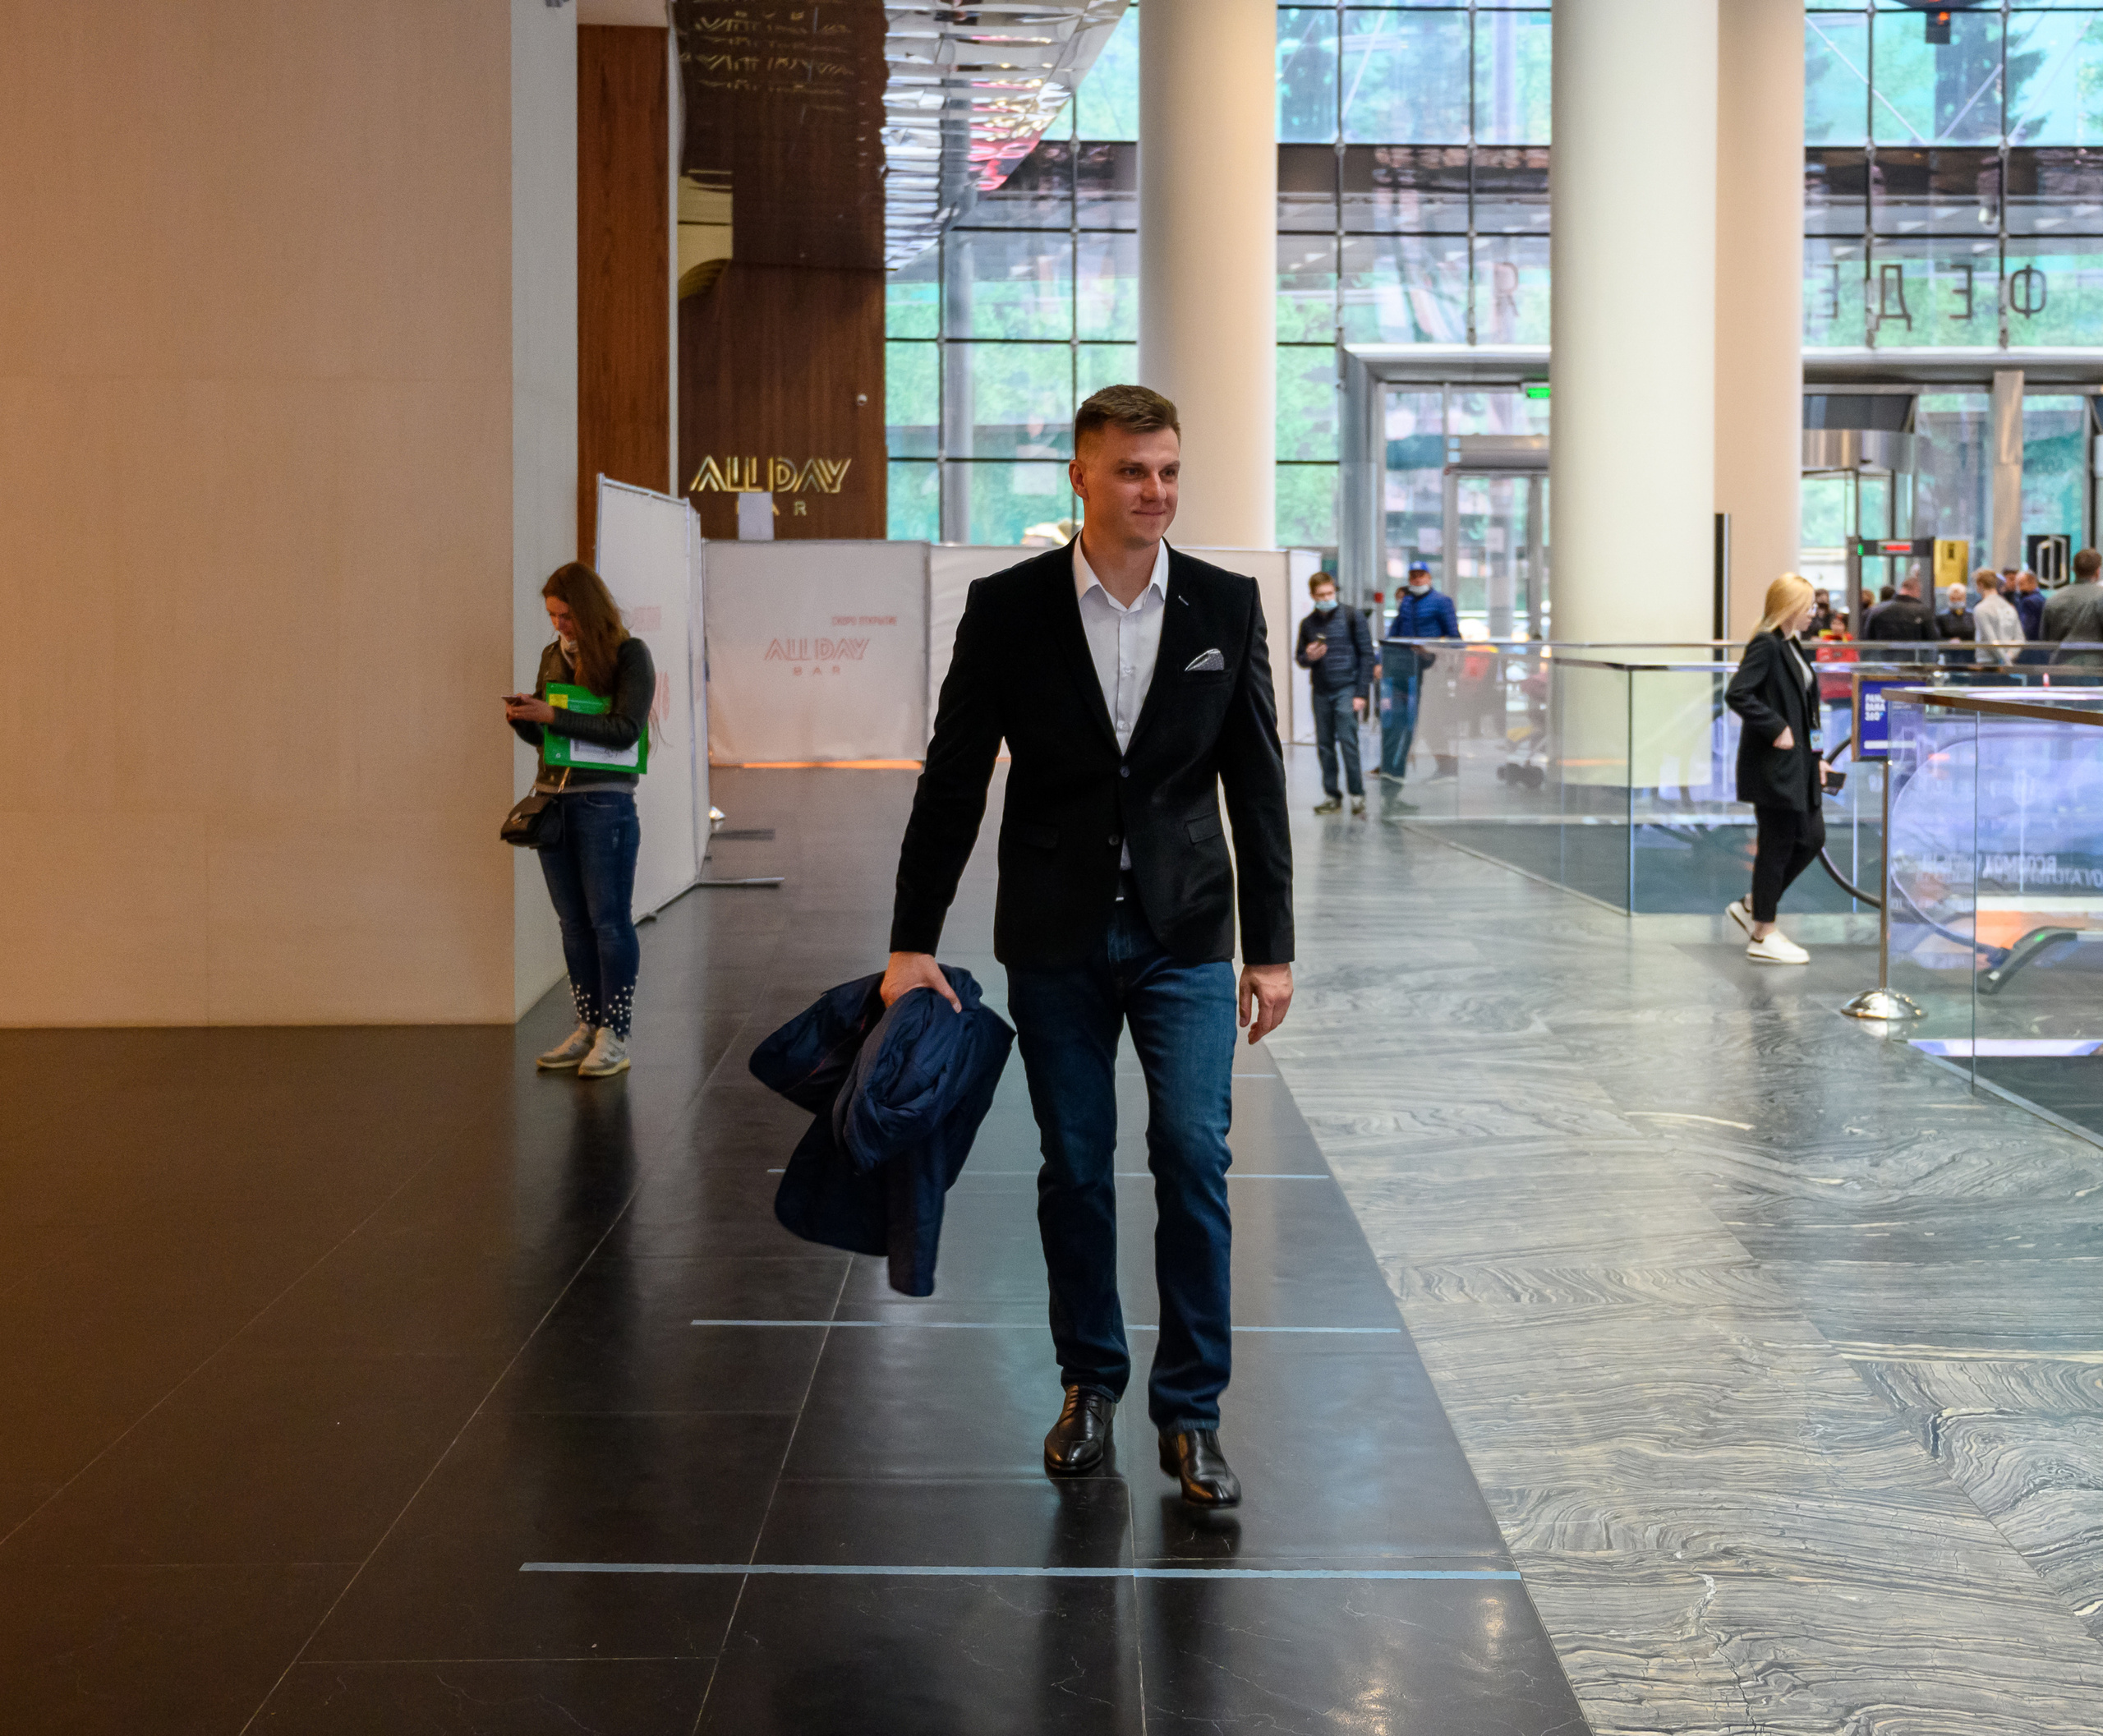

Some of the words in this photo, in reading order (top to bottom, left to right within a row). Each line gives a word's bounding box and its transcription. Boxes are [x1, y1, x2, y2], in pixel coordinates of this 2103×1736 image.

[689, 455, 763, 493] ALL
[766, 457, 853, 493] DAY
[764, 638, 812, 661] ALL
[814, 638, 870, 661] DAY
[793, 665, 841, 676] BAR
